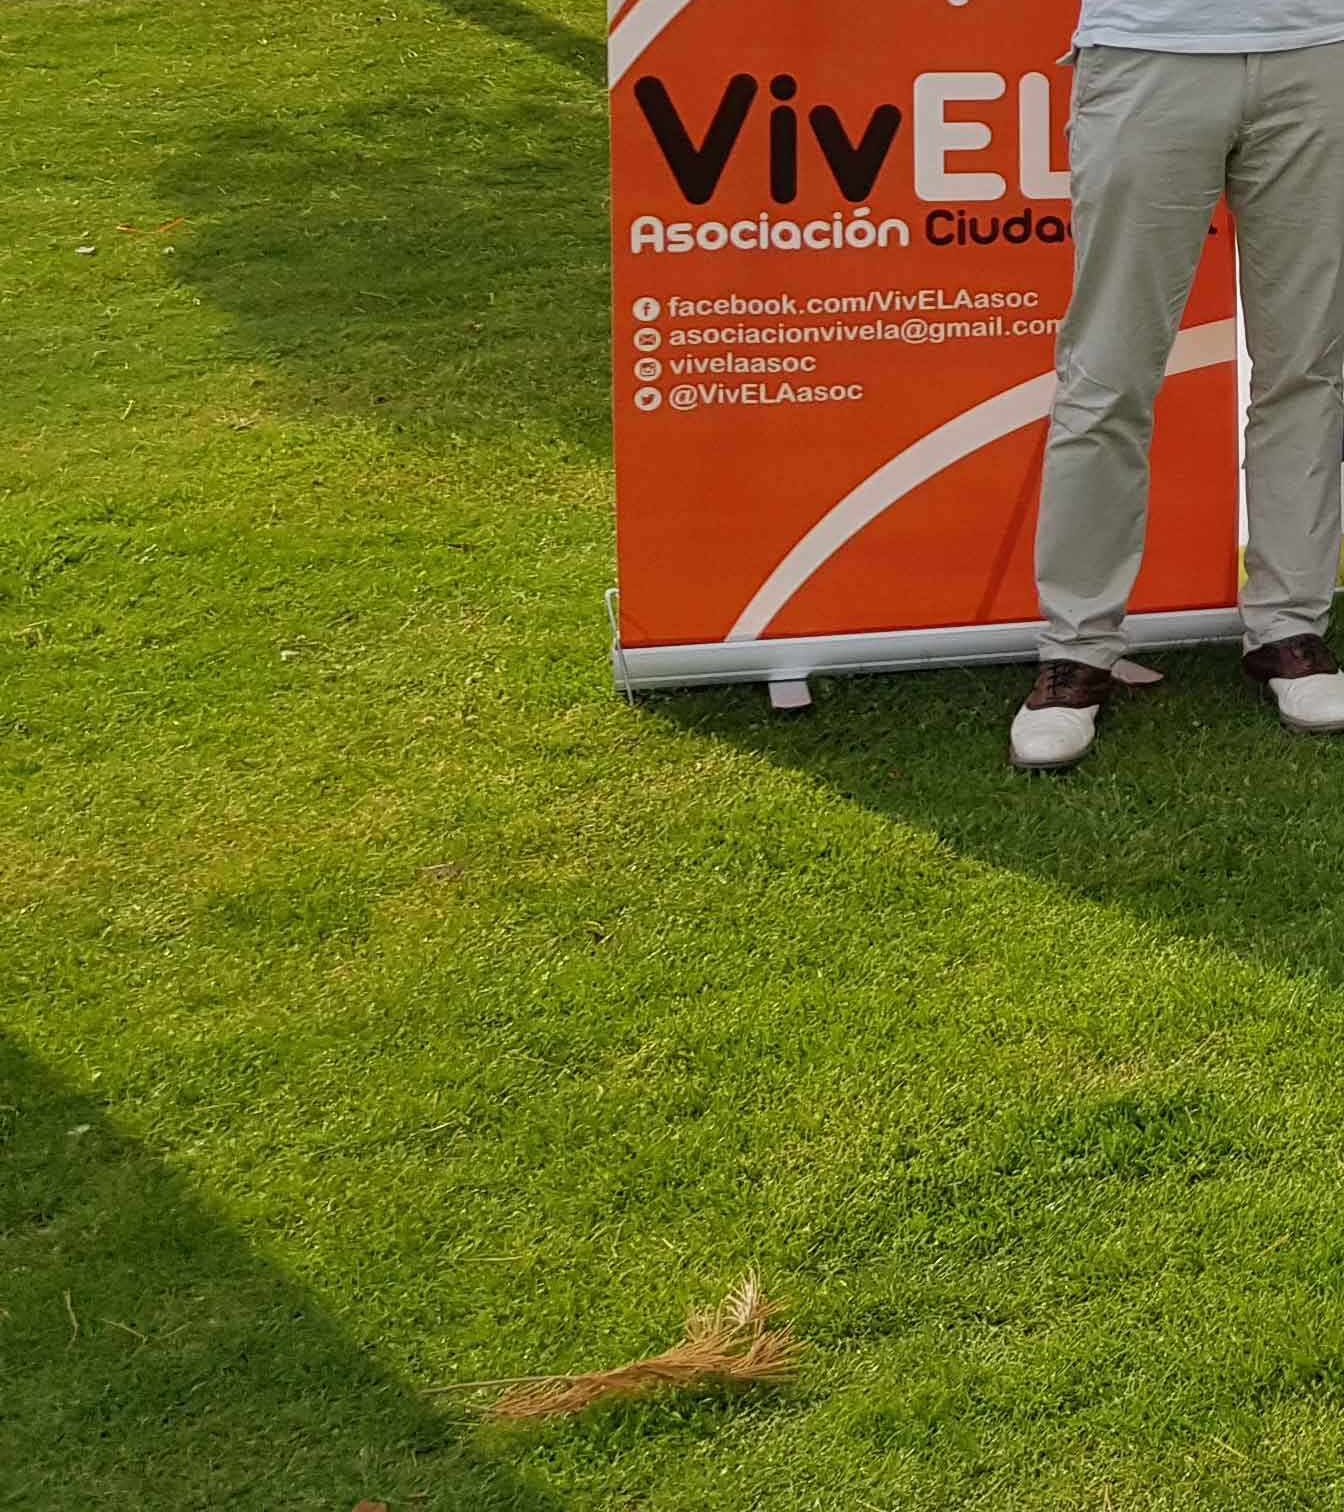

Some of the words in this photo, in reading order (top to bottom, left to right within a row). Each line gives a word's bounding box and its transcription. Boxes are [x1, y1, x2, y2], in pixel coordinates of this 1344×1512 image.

[633, 70, 1072, 206] VivEL
[630, 206, 910, 254] Asociación
[925, 208, 1075, 247] Ciuda
[667, 288, 1040, 319] facebook.com/VivELAasoc
[669, 353, 817, 377] vivelaasoc
[669, 381, 864, 411] @VivELAasoc
